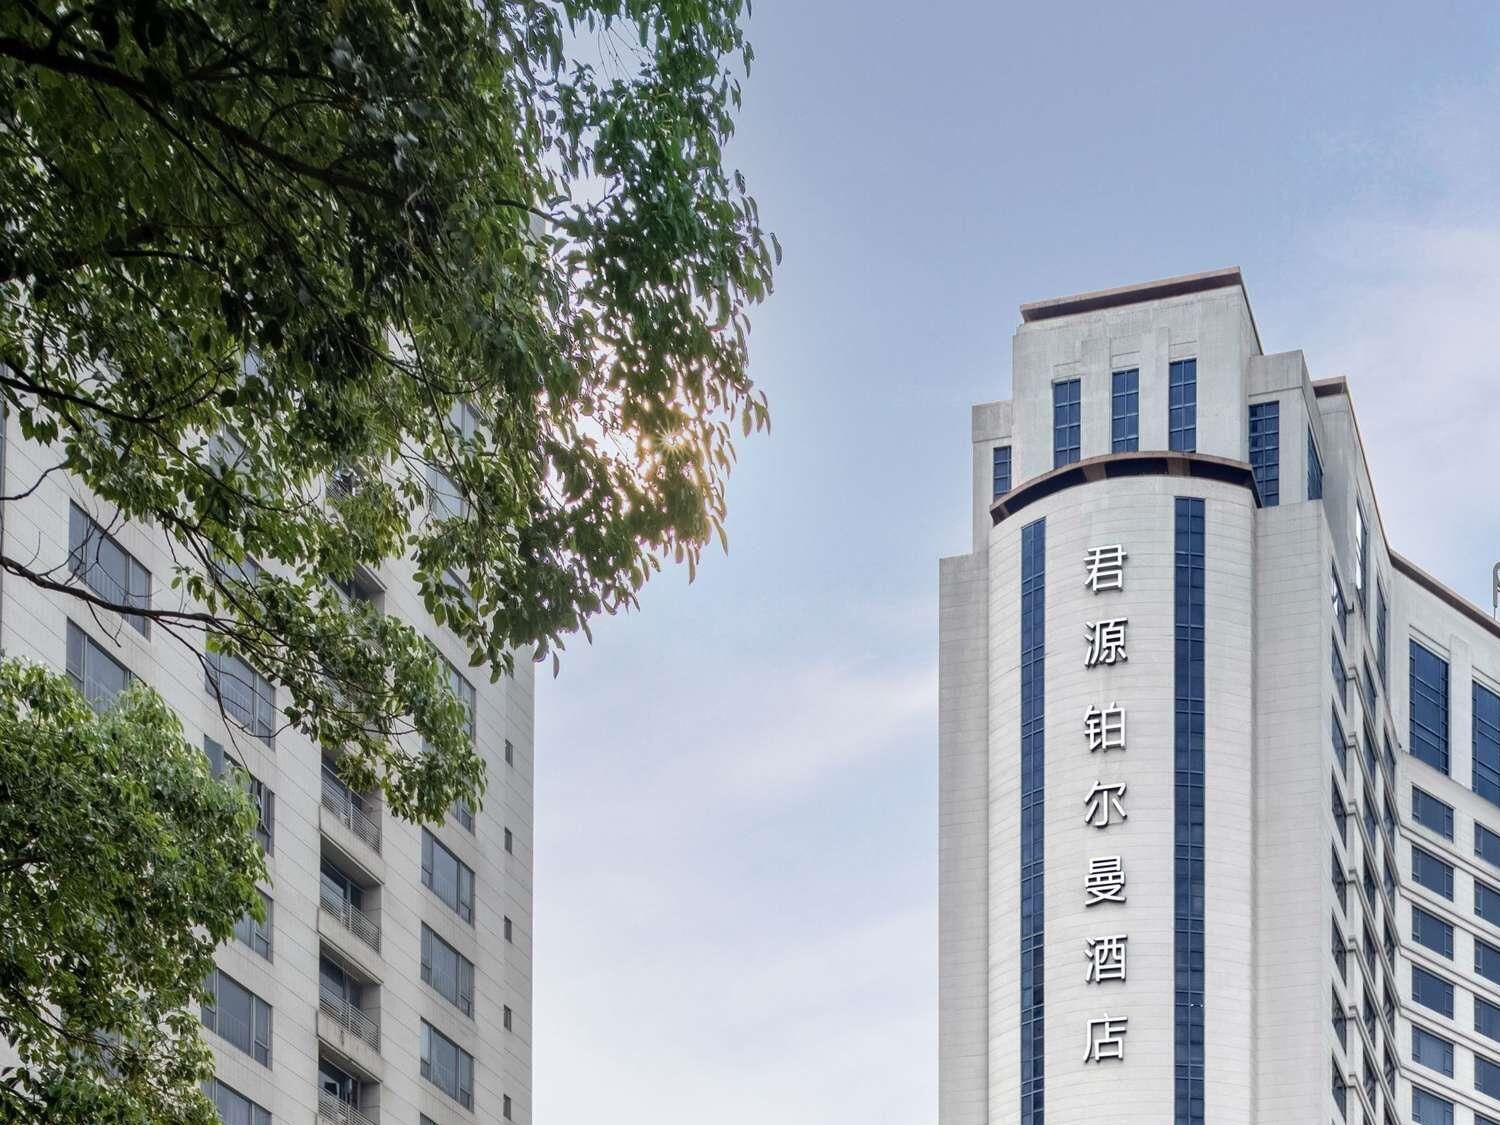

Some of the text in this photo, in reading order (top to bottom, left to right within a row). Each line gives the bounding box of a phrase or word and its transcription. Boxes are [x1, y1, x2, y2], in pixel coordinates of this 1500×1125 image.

[1083, 543, 1128, 1064] 君源铂尔曼酒店
